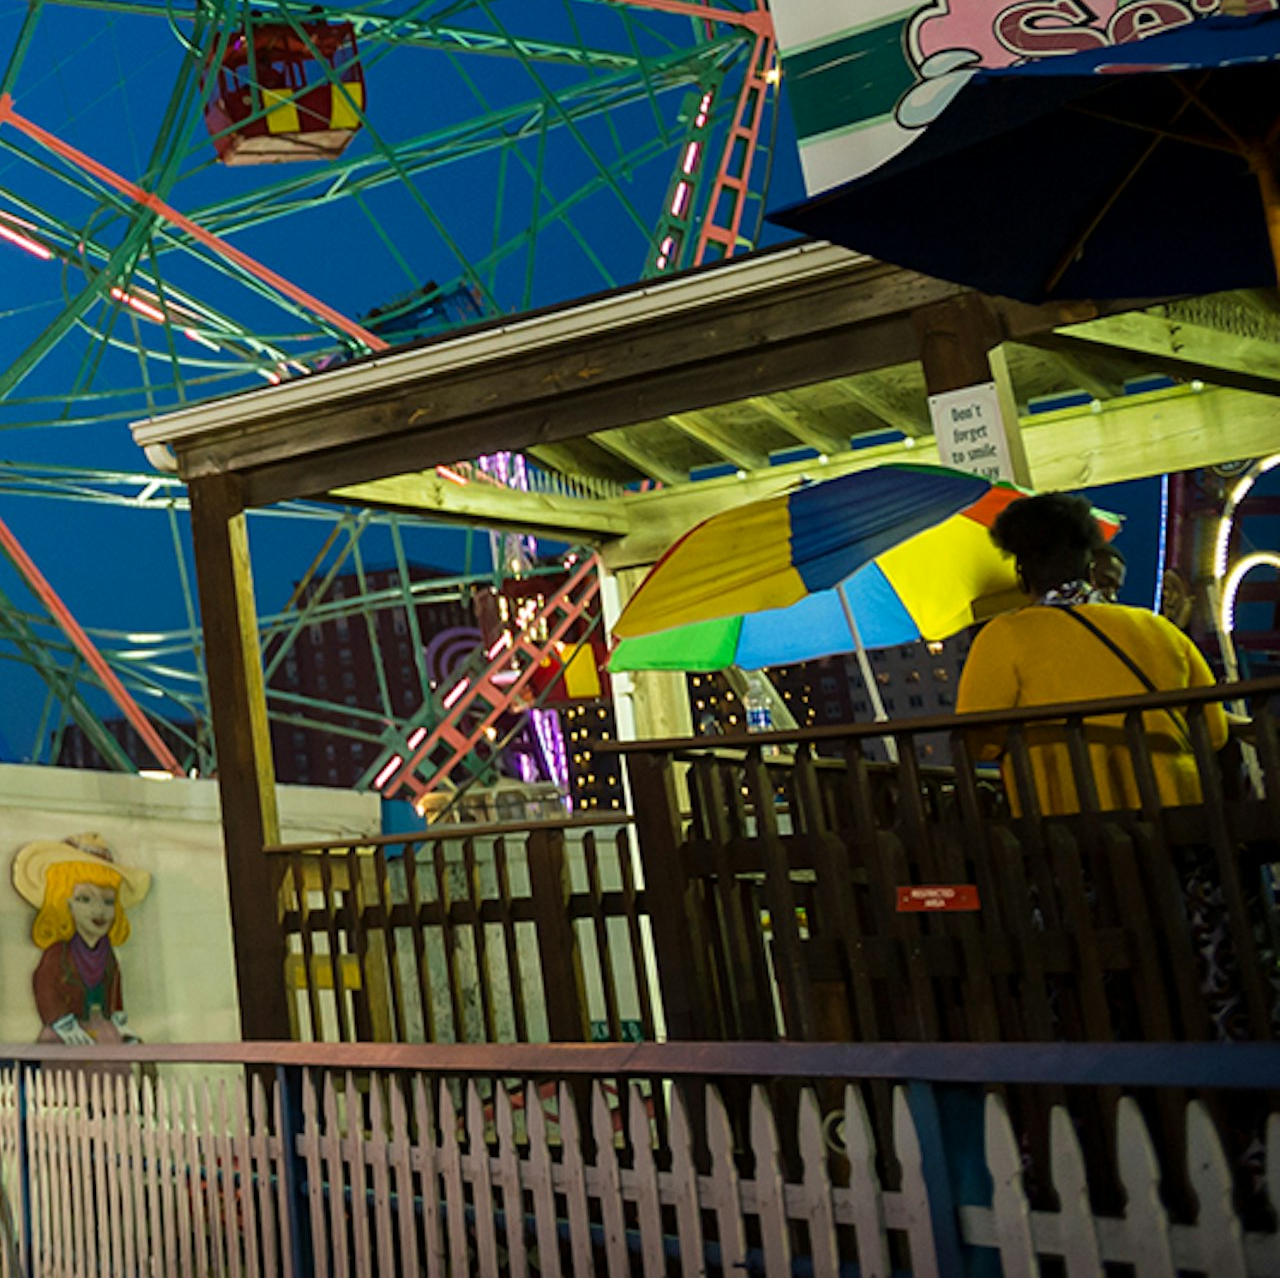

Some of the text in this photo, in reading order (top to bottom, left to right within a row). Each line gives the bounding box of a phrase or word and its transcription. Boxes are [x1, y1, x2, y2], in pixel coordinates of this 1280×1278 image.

[953, 425, 988, 443] forget
[952, 443, 997, 464] to smile
